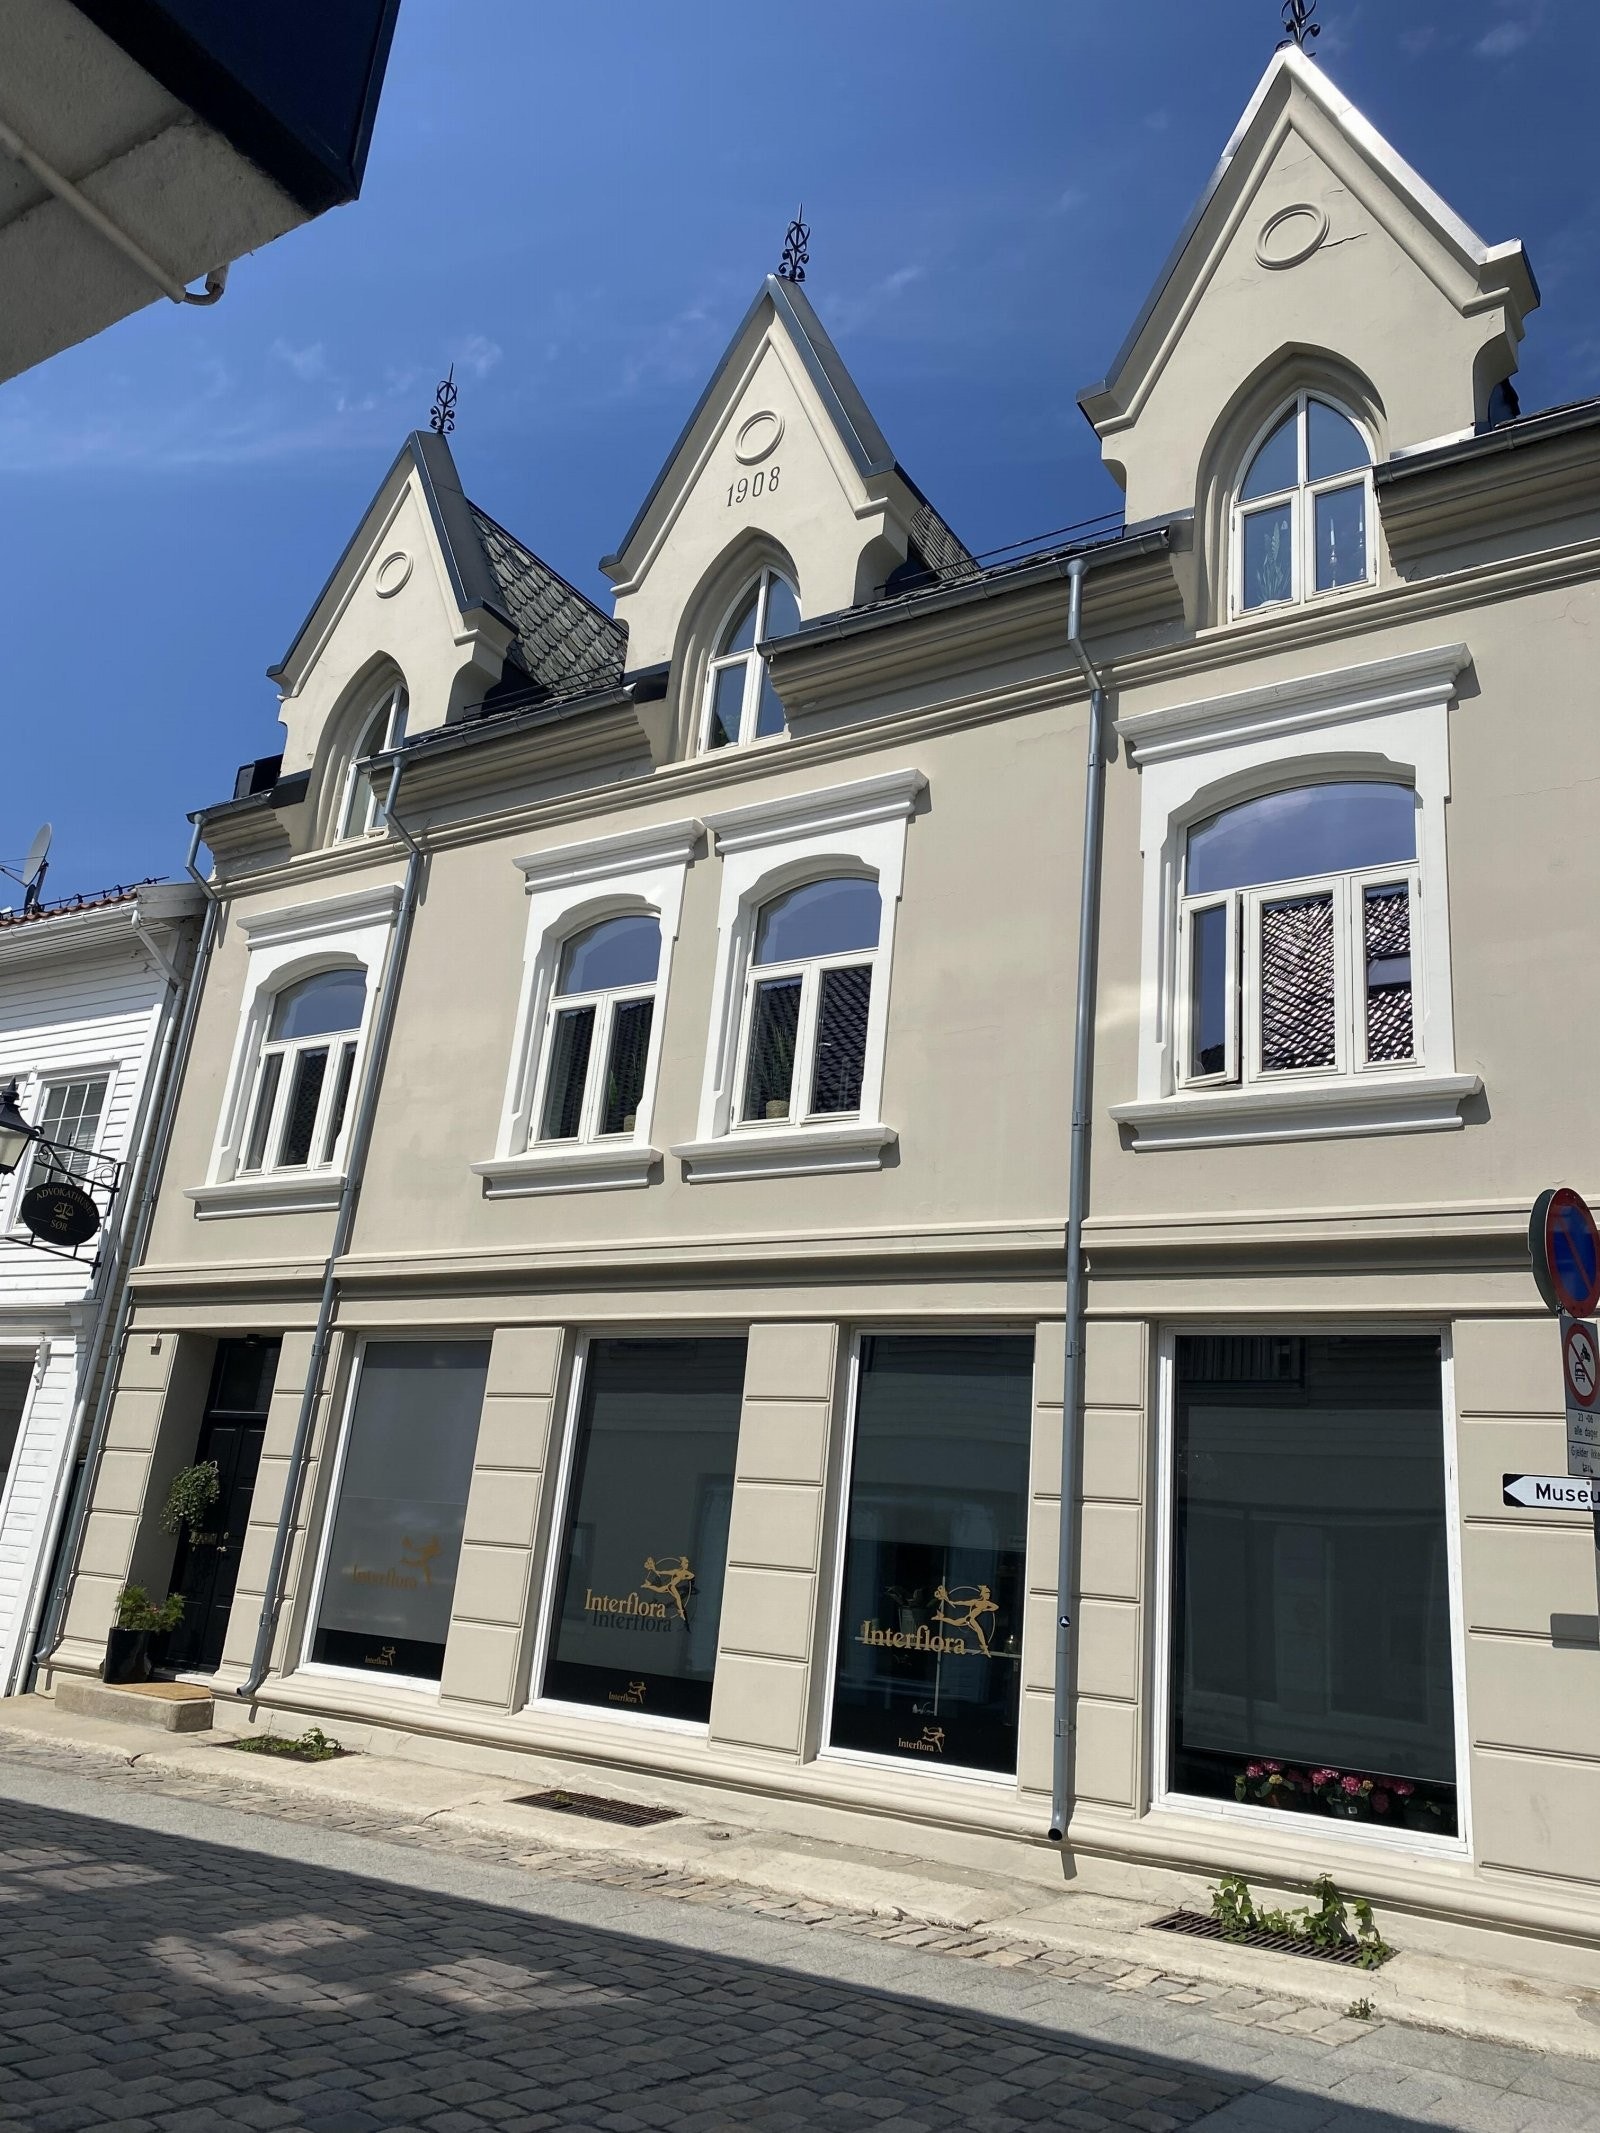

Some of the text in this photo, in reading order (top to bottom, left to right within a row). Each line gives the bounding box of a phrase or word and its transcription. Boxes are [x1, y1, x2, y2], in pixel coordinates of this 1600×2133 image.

[727, 466, 780, 507] 1908
[36, 1187, 95, 1218] ADVOKATHUSET
[50, 1219, 68, 1232] SØR
[584, 1588, 667, 1618] Interflora
[861, 1620, 966, 1655] Interflora
[608, 1691, 637, 1704] Interflora
[898, 1737, 935, 1752] Interflora
